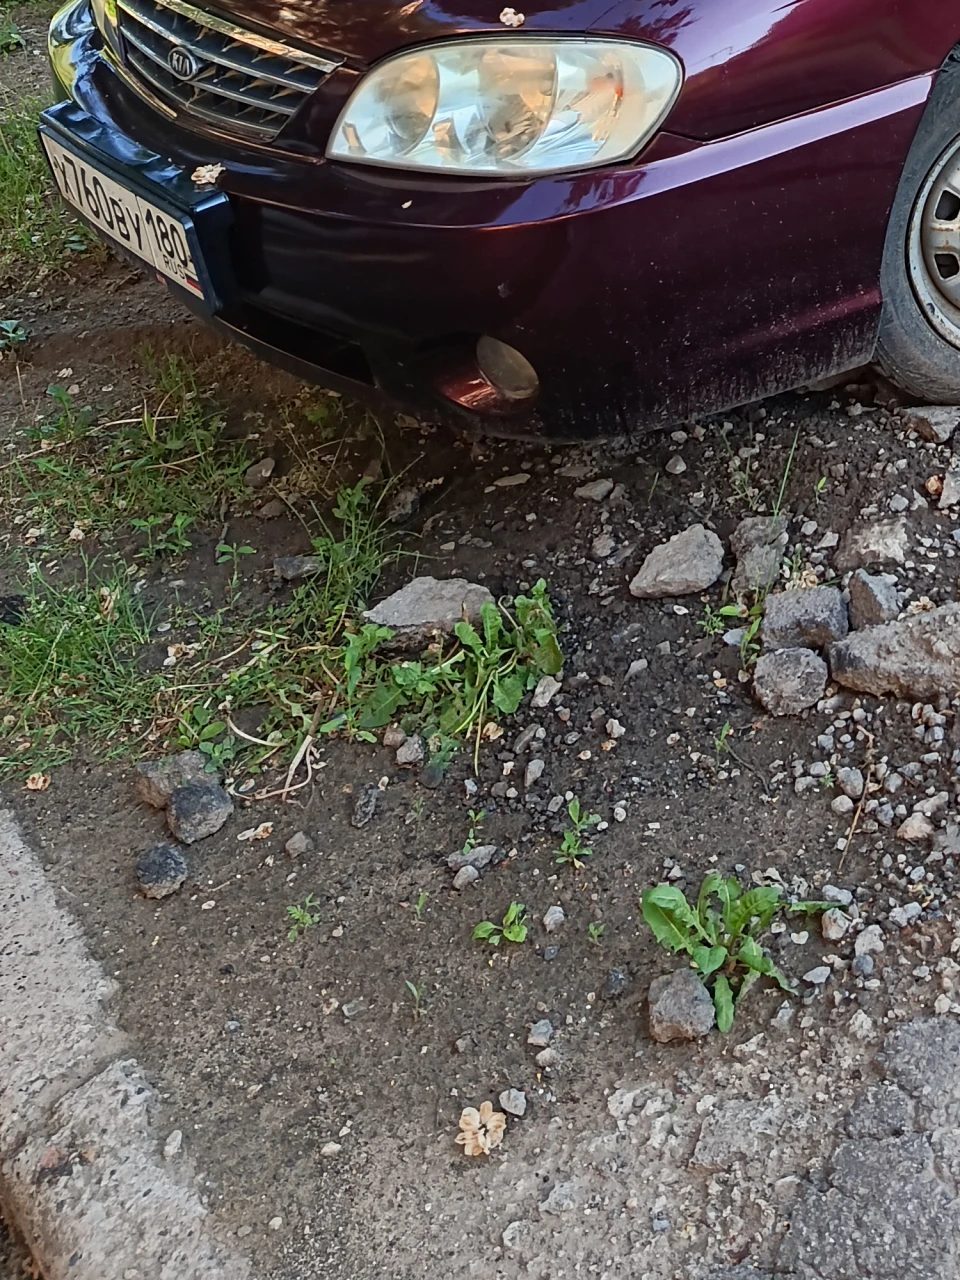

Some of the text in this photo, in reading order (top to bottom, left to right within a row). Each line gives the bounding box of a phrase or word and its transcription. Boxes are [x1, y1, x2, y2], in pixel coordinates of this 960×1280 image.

[172, 52, 190, 75] KIA
[145, 208, 189, 268] 180
[163, 254, 186, 280] RUS
